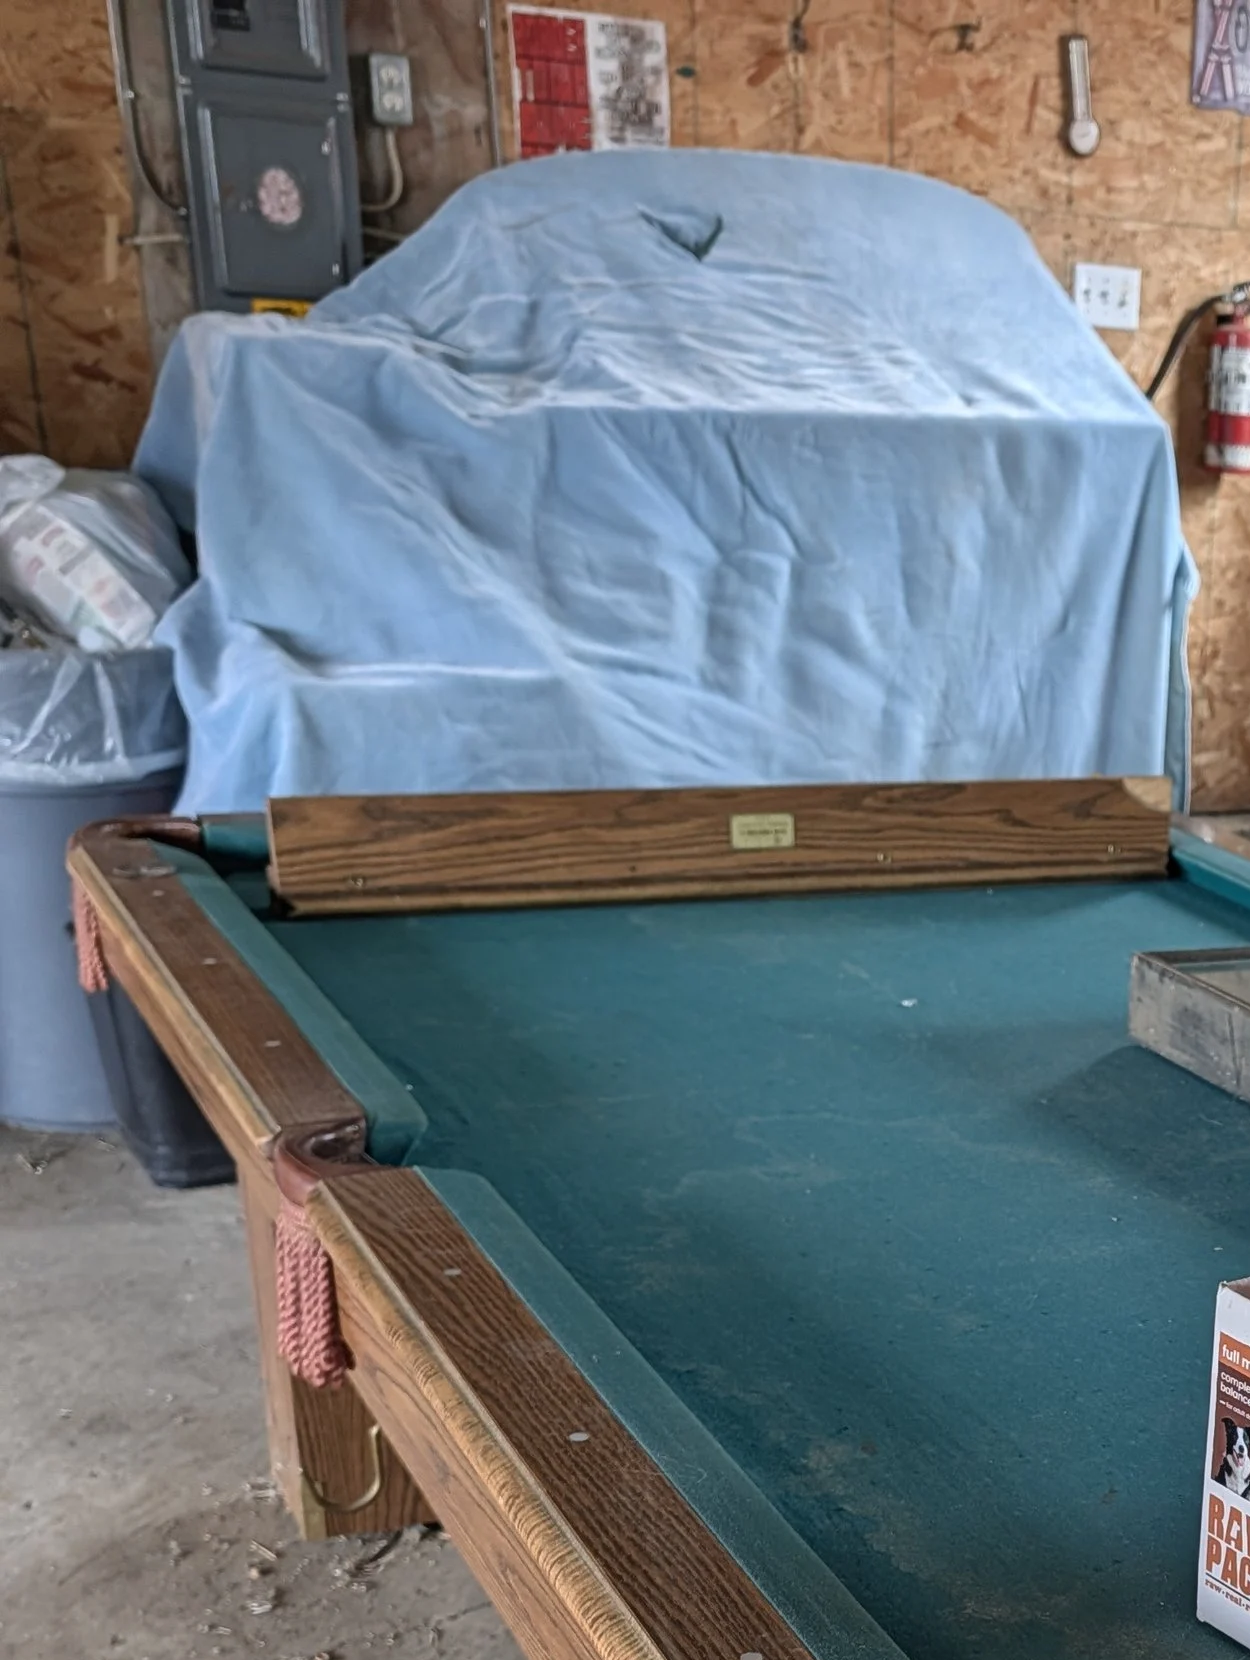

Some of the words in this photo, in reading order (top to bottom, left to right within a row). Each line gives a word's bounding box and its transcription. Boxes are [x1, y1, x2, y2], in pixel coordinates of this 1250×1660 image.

[1222, 1344, 1240, 1365] full
[1205, 1579, 1221, 1594] raw
[1225, 1590, 1242, 1607] real
